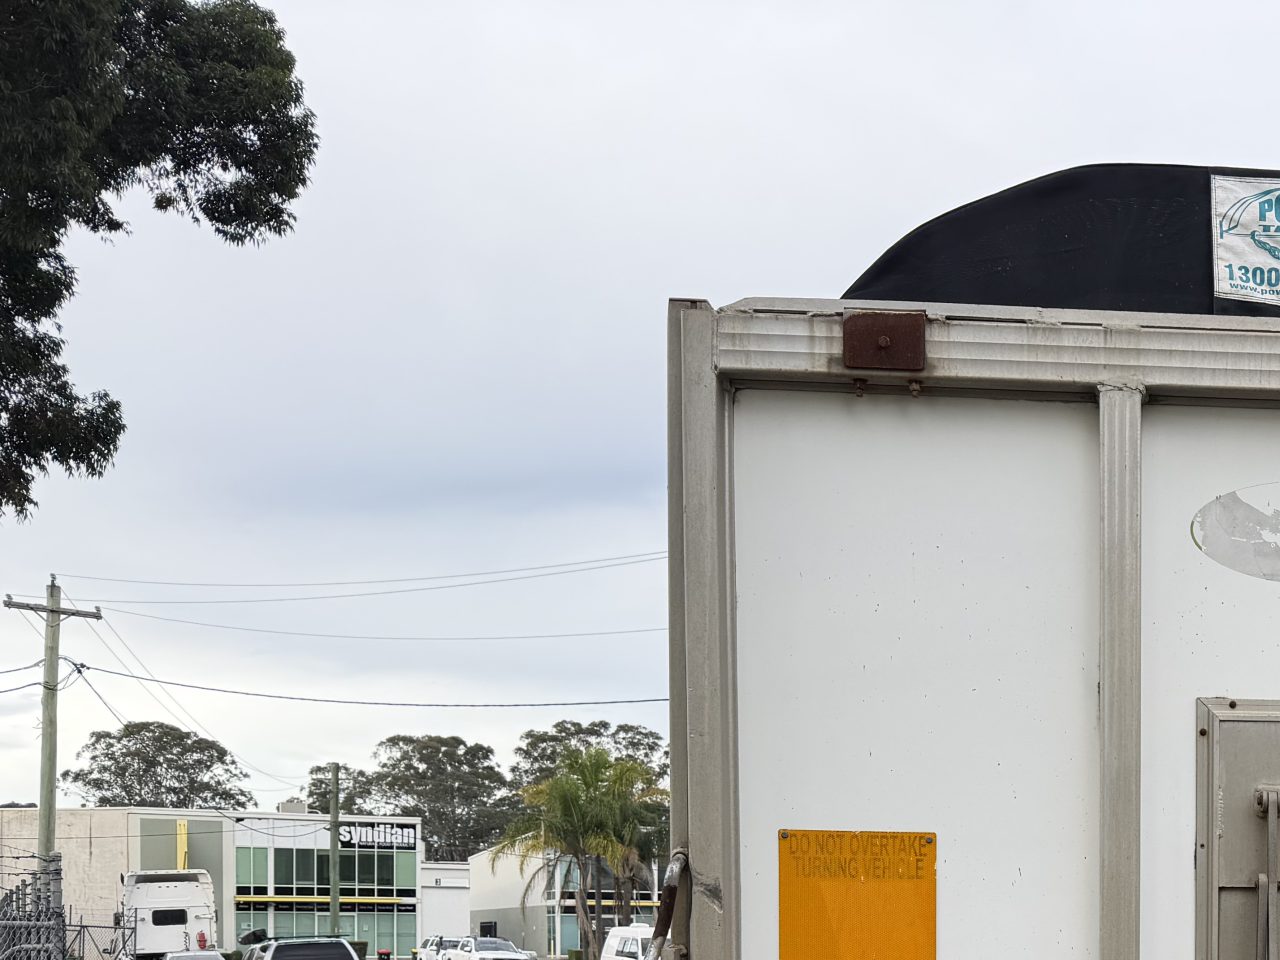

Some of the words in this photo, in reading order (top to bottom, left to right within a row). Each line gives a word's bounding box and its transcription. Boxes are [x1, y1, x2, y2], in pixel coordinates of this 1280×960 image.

[1224, 263, 1280, 288] 1300
[339, 824, 415, 844] syndian
[788, 833, 810, 856] DO
[815, 834, 846, 857] NOT
[849, 834, 928, 858] OVERTAKE
[793, 856, 859, 879] TURNING
[863, 857, 925, 880] VEHICLE
